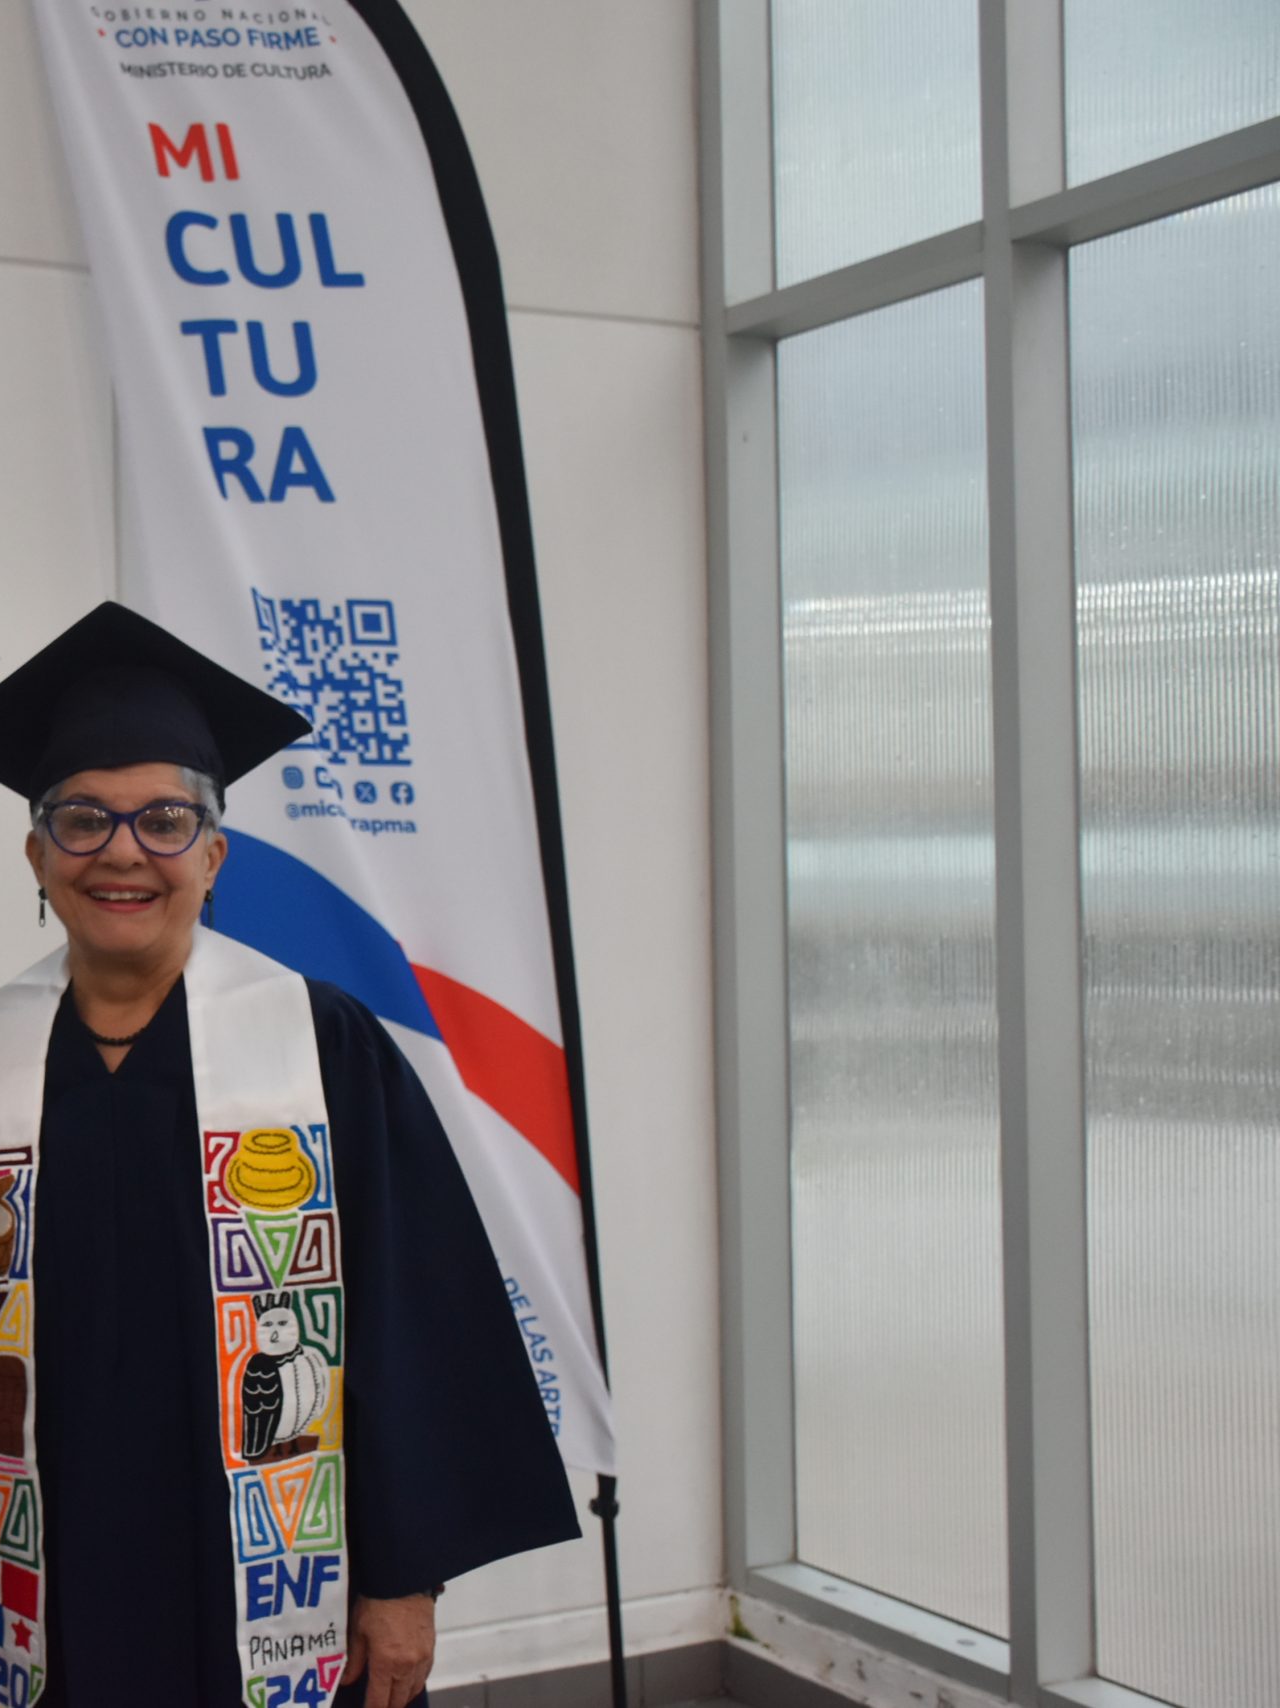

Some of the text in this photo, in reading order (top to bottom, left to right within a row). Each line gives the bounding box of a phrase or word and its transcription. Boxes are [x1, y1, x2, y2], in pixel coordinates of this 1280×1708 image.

[115, 26, 321, 51] CON PASO FIRME
[120, 61, 333, 81] MINISTERIO DE CULTURA
[148, 122, 240, 182] MI
[165, 211, 365, 289] CUL
[180, 319, 318, 397] TU
[202, 426, 336, 503] RA
[504, 1277, 531, 1313] DE
[520, 1315, 553, 1363] LAS
[246, 1555, 340, 1622] ENF
[249, 1622, 336, 1670] PANAMÁ
[266, 1668, 327, 1708] 24
